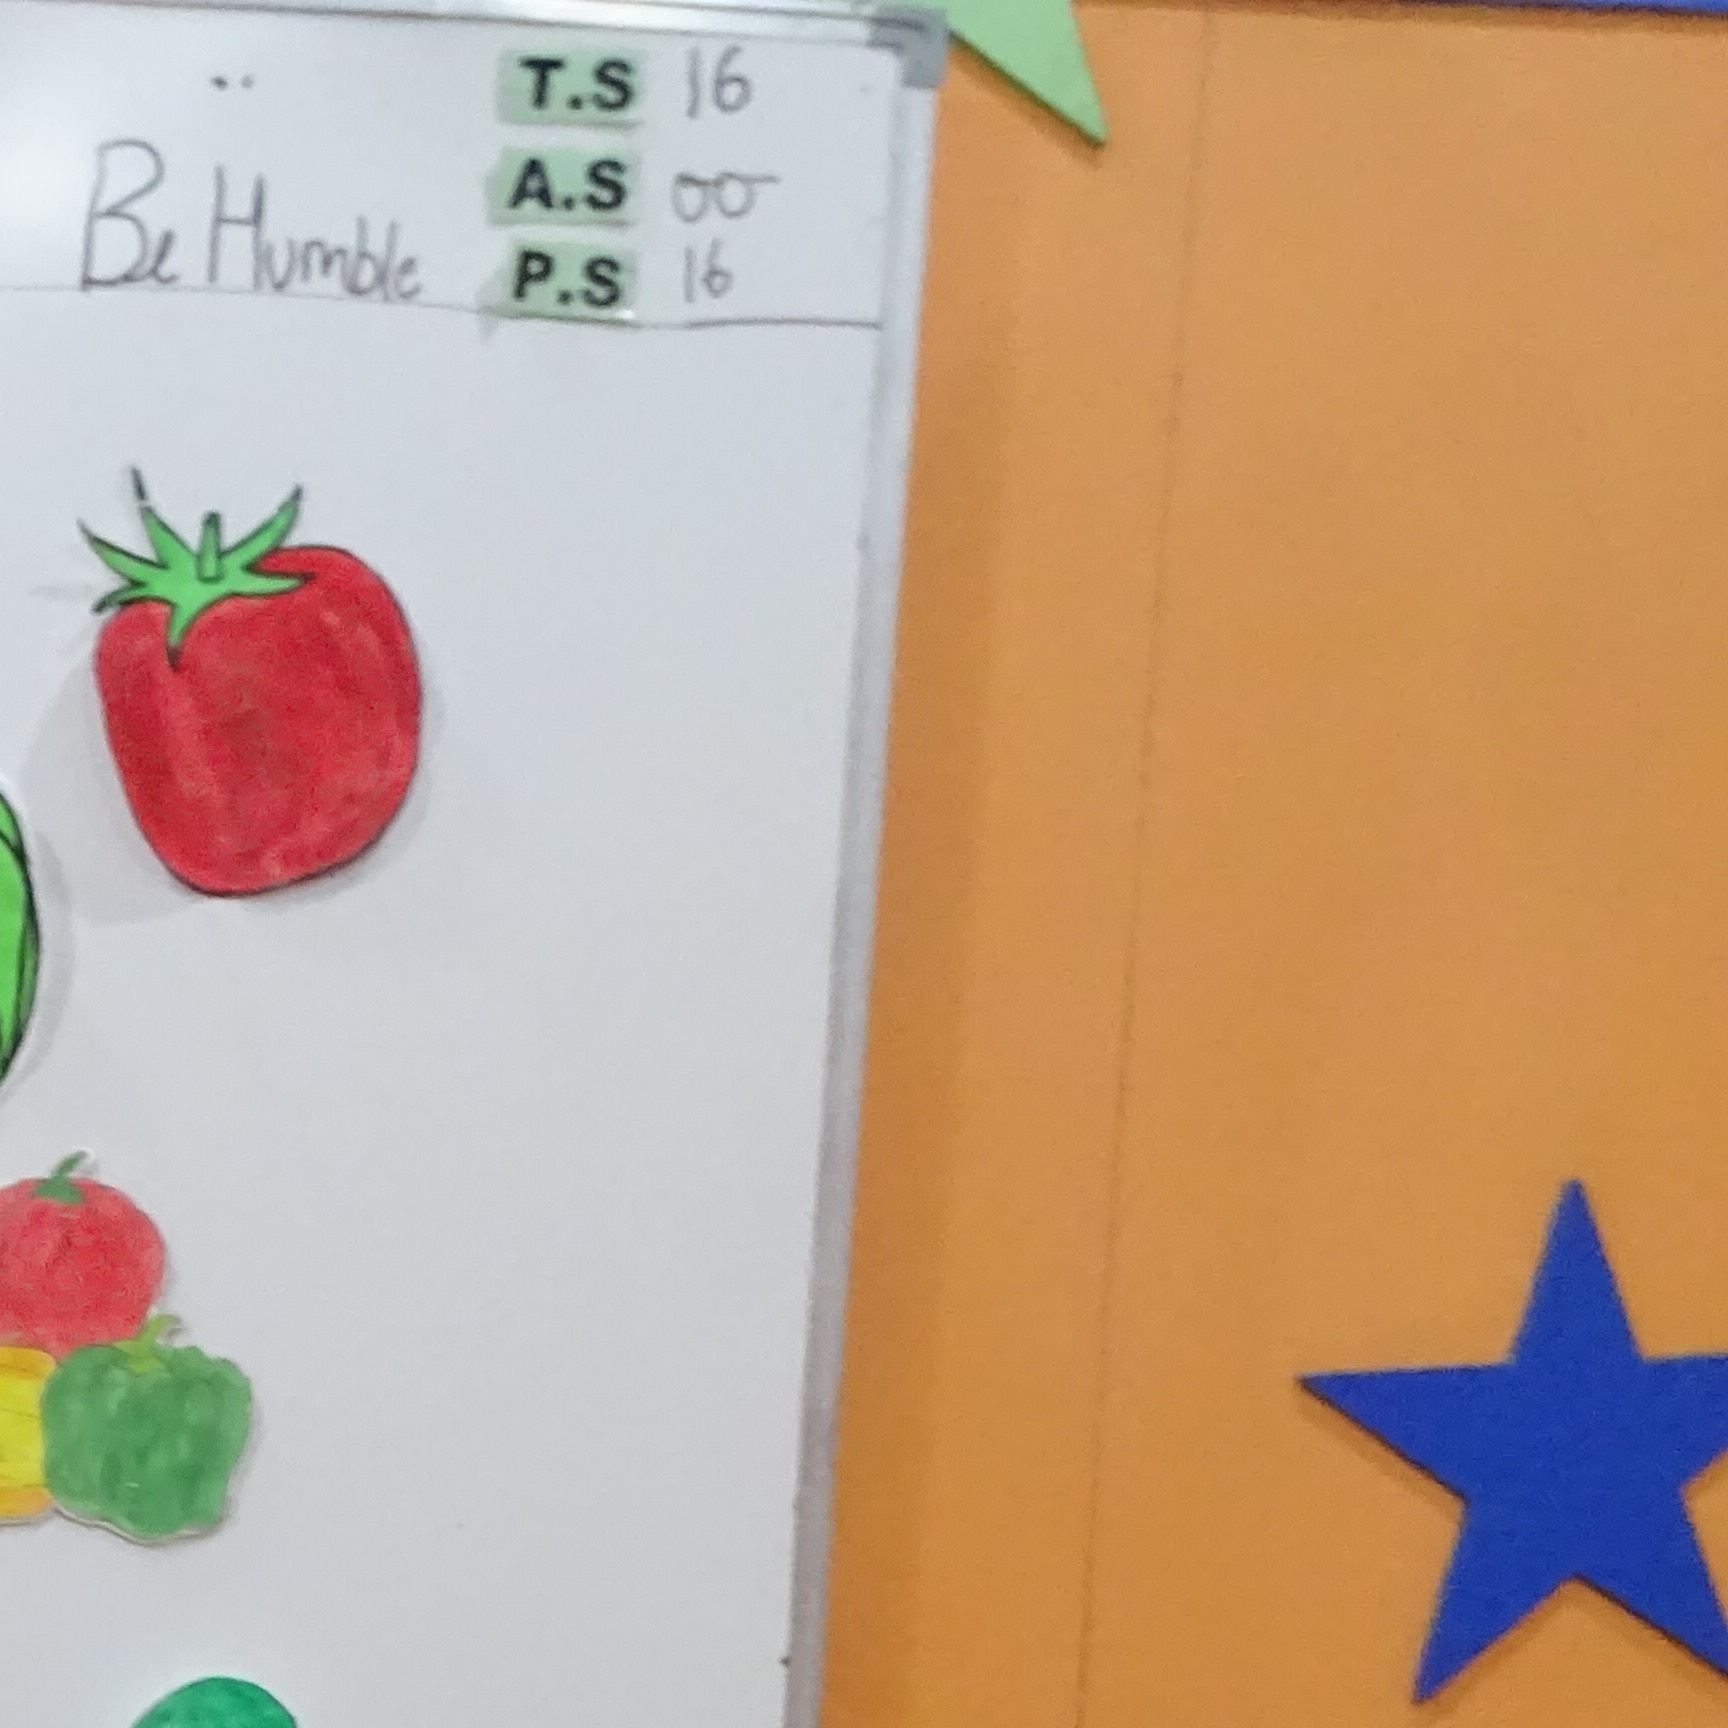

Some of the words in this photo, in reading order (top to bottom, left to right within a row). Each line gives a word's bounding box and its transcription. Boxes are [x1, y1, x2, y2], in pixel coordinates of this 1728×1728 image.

[518, 57, 635, 112] T.S
[686, 45, 752, 119] 16
[509, 157, 628, 211] A.S
[78, 138, 179, 292] Be
[207, 163, 424, 300] Humble
[512, 248, 623, 307] P.S
[683, 238, 734, 303] 16
